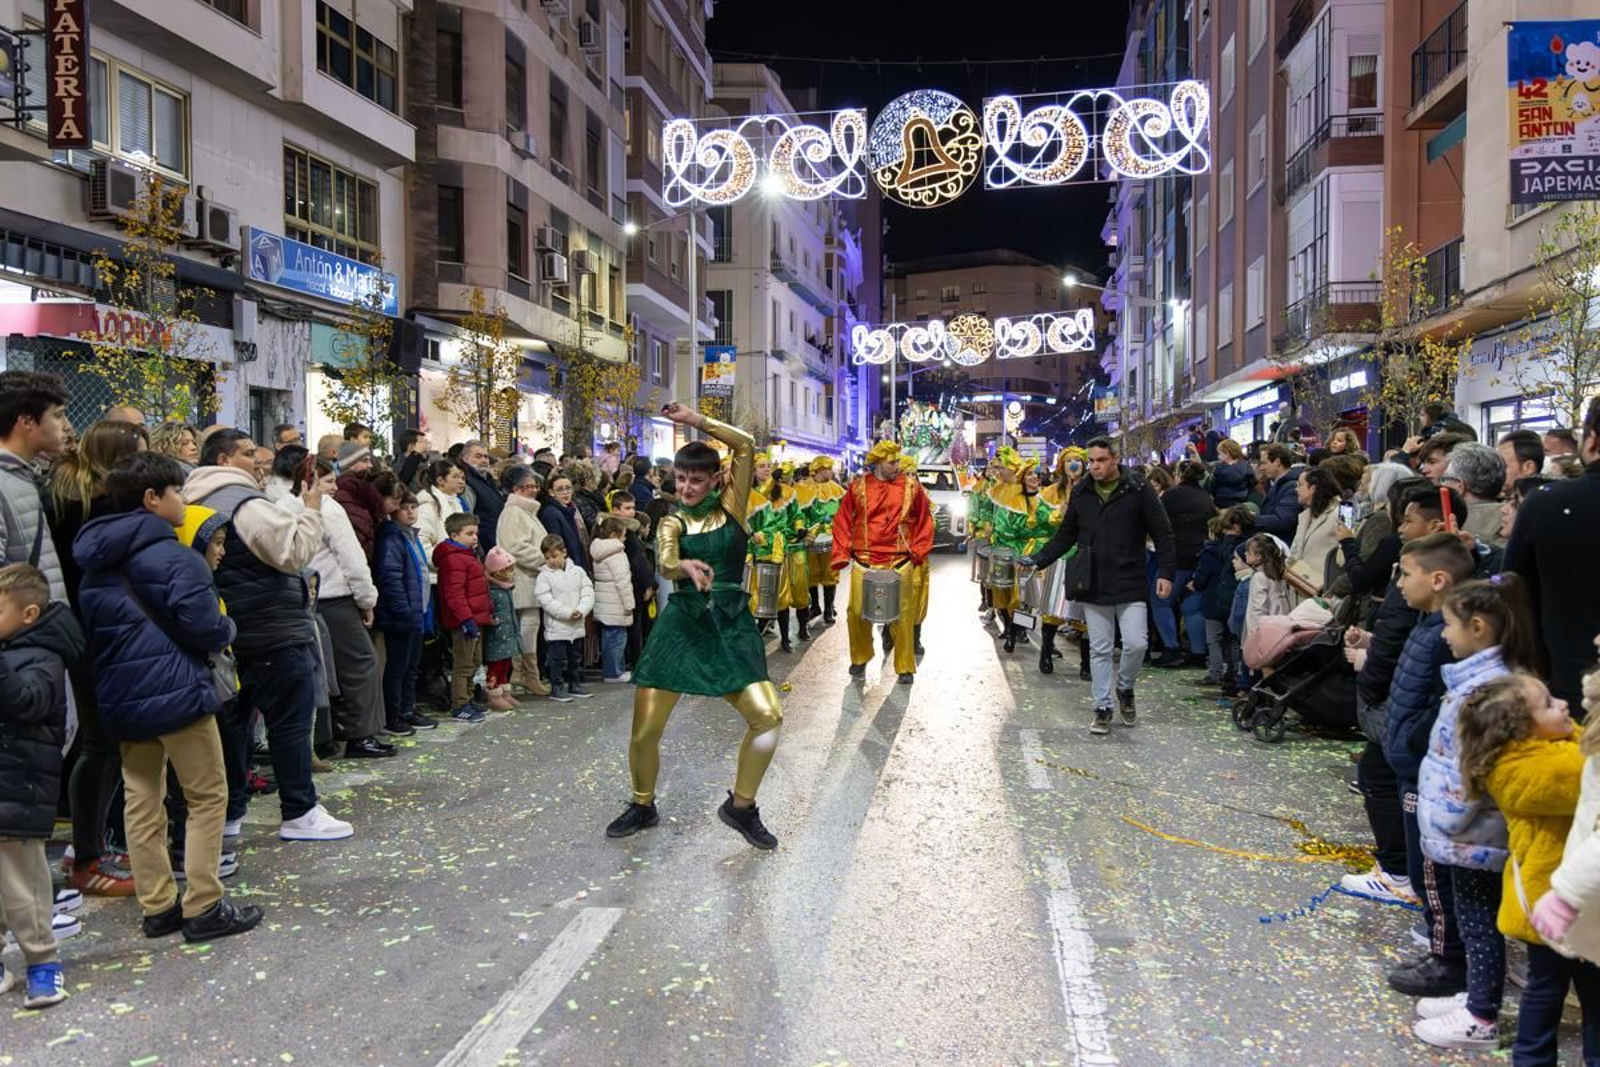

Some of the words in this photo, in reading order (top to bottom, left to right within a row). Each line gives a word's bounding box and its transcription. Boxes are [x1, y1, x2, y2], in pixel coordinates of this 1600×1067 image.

[1518, 78, 1548, 99] 42
[1518, 106, 1553, 123] SAN
[1520, 159, 1600, 174] DACI
[294, 247, 332, 281] Antón
[334, 262, 345, 285] &
